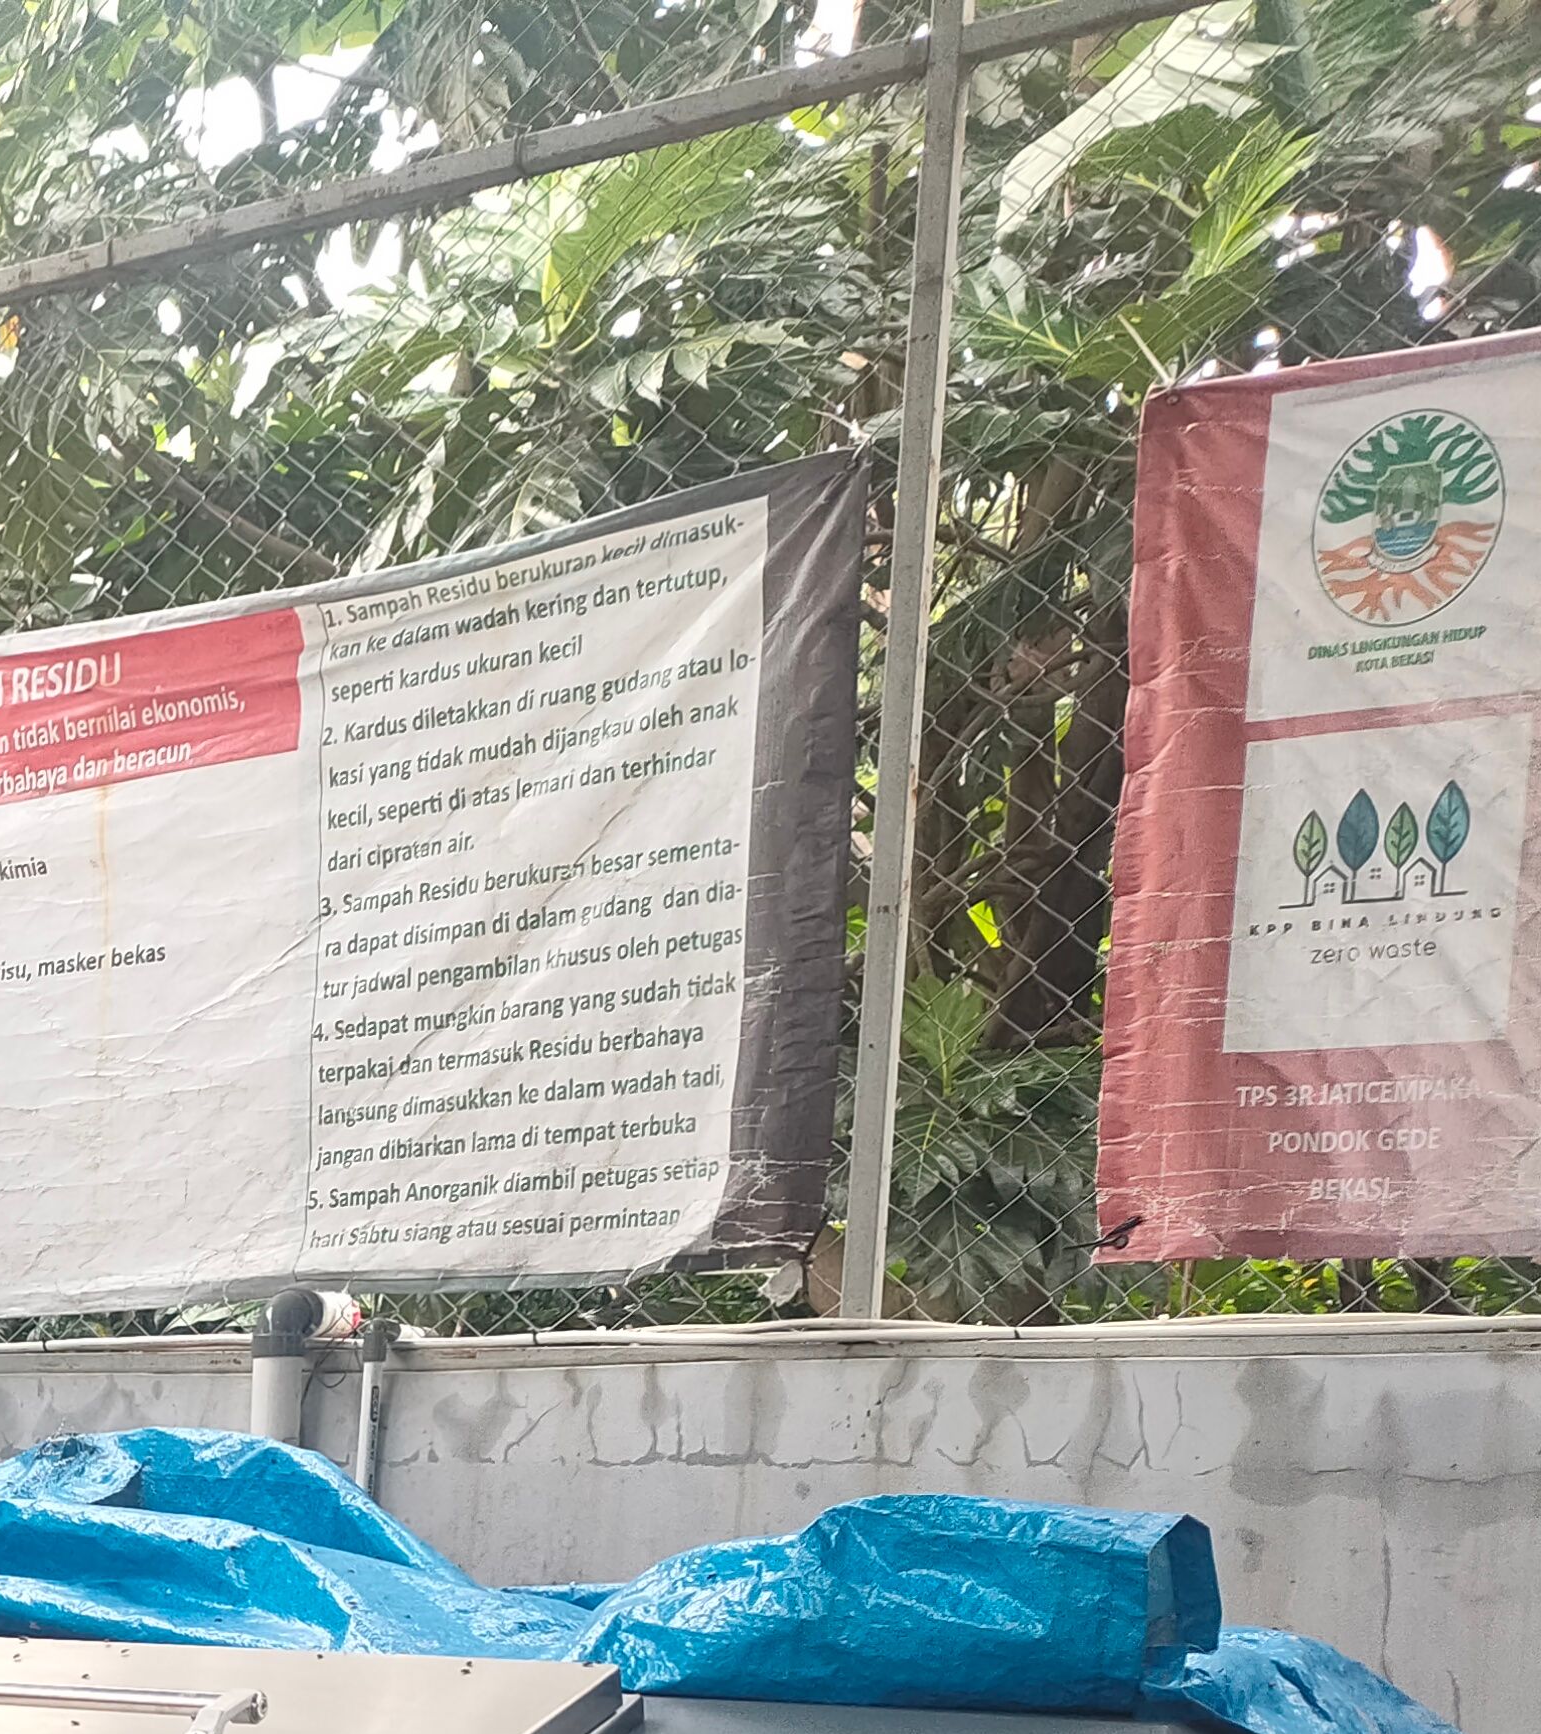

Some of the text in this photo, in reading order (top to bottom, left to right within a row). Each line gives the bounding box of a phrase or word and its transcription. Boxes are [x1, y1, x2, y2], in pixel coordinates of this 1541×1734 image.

[327, 514, 743, 629] 1. Sampah Residu berukuran kecil dimasuk-
[330, 566, 728, 661] kan ke dalam wadah kering dan tertutup,
[1308, 642, 1348, 660] DINAS
[1442, 626, 1487, 641] HIDUP
[11, 652, 121, 705] RESIDU
[1356, 650, 1434, 673] KOTA BEKASI
[322, 650, 756, 746] 2. Kardus diletakkan di ruang gudang atau lo-
[12, 723, 60, 753] tidak
[64, 709, 137, 741] bernilai
[141, 685, 246, 727] ekonomis,
[329, 697, 738, 788] kasi yang tidak mudah dijangkau oleh anak
[73, 755, 107, 781] dan
[113, 744, 192, 774] beracun
[0, 858, 47, 882] kimia
[1249, 922, 1294, 936] KPP
[1311, 916, 1370, 932] BINA
[38, 953, 105, 977] masker
[111, 944, 166, 968] bekas
[1311, 938, 1437, 965] zero waste
[318, 1024, 704, 1085] terpakai dan termasuk Residu berbahaya
[1237, 1077, 1482, 1107] TPS 3R JATICEMPAKA
[316, 1110, 696, 1171] jangan dibiarkan lama di tempat terbuka
[1267, 1127, 1442, 1154] PONDOK GEDE
[1309, 1177, 1391, 1201] BEKASI
